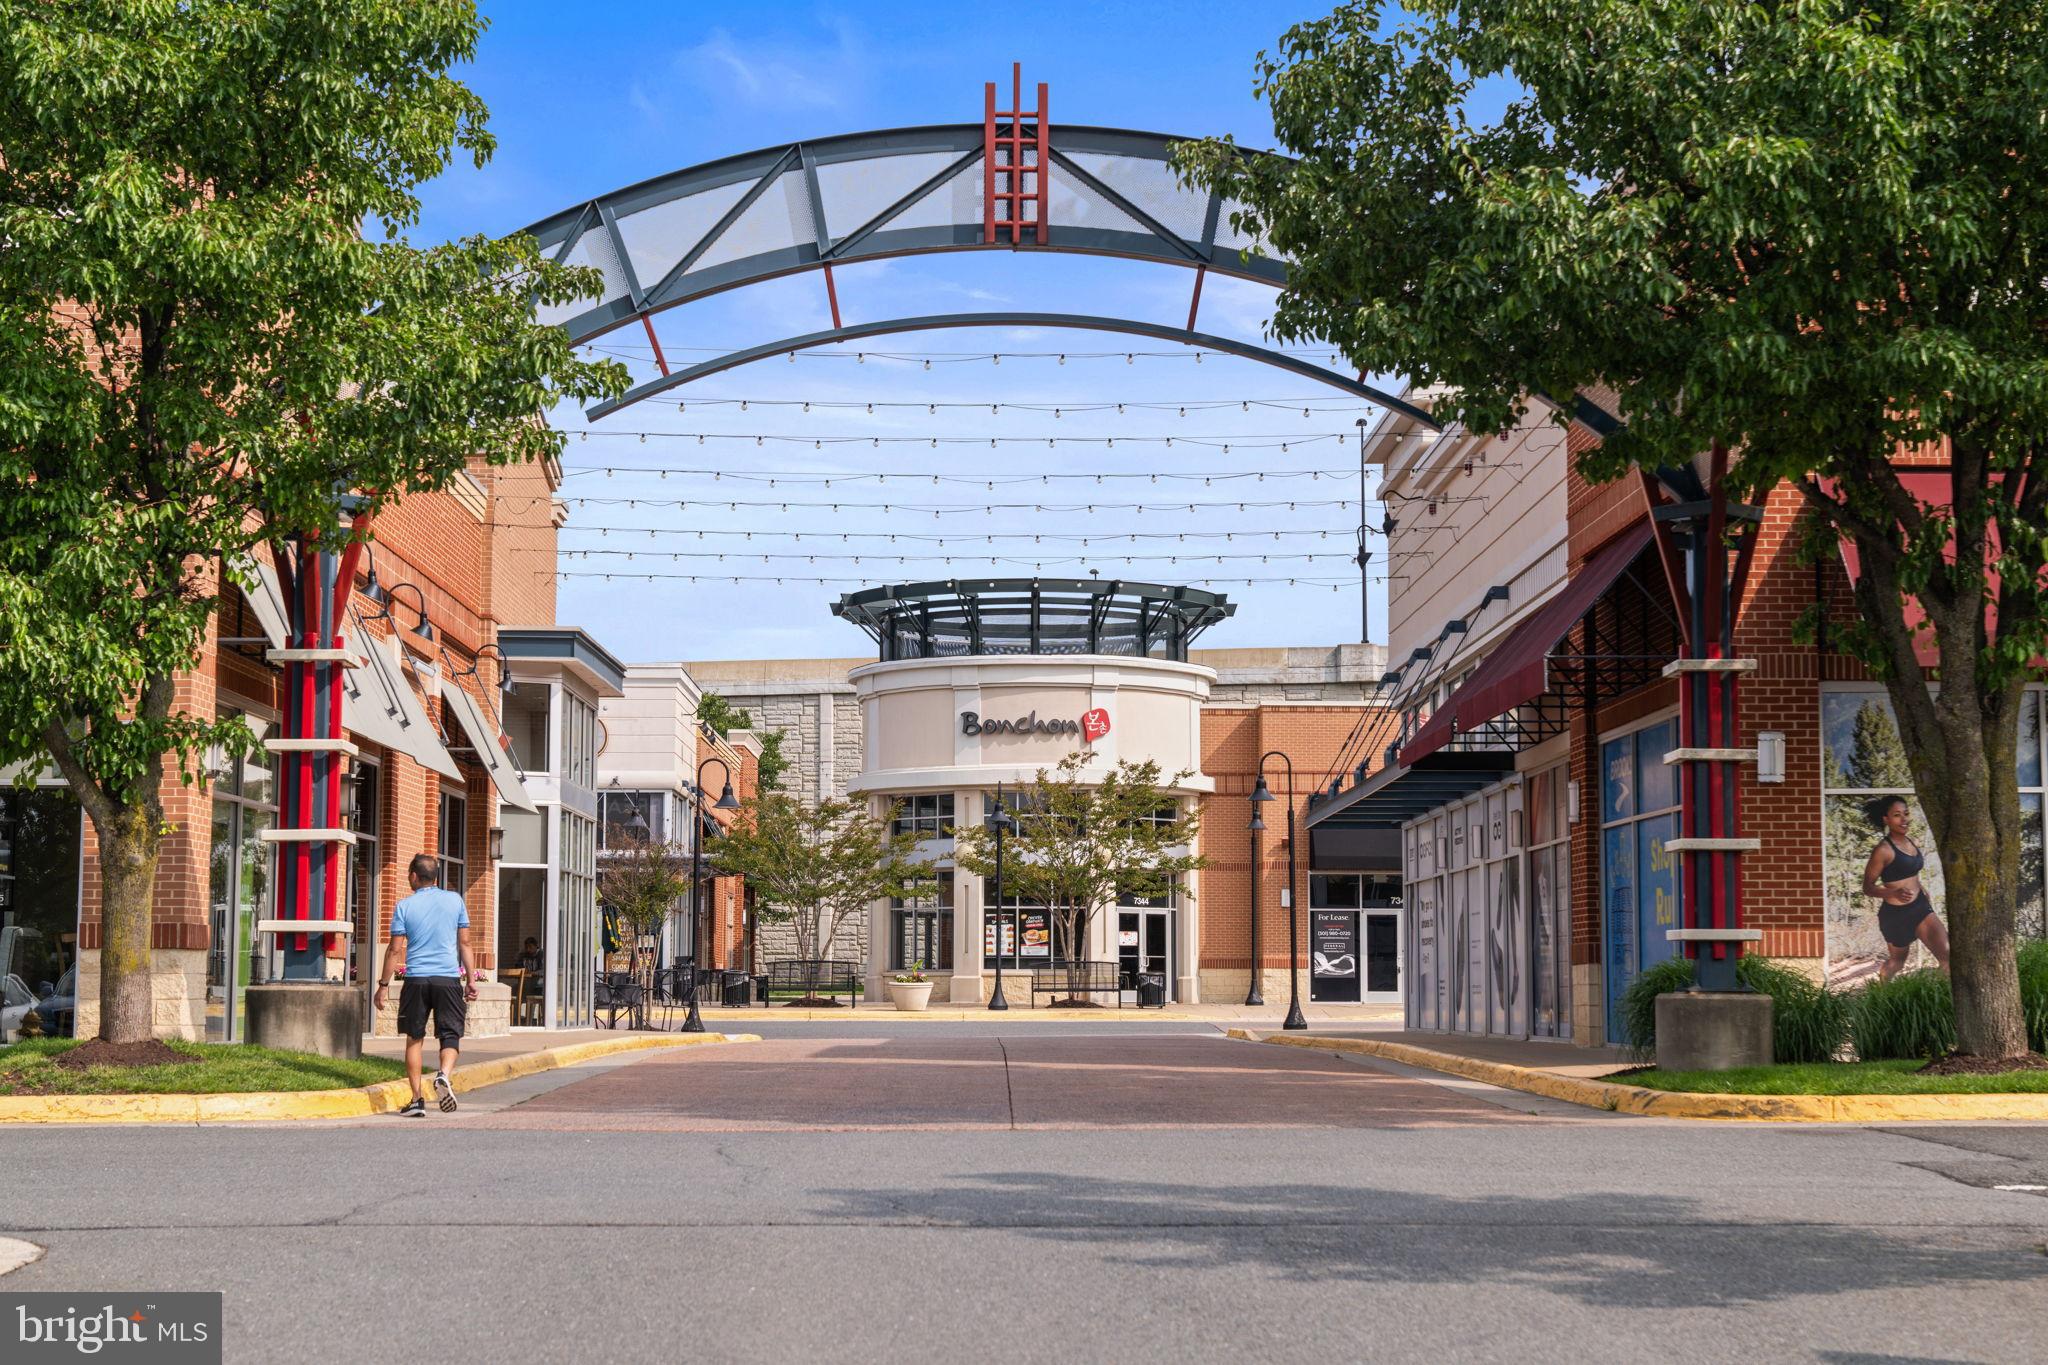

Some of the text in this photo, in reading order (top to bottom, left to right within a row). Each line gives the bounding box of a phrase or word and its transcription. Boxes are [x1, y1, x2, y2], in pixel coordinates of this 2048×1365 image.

[960, 710, 1080, 737] Bonchon
[1133, 897, 1150, 905] 7344
[1656, 887, 1672, 926] Ru
